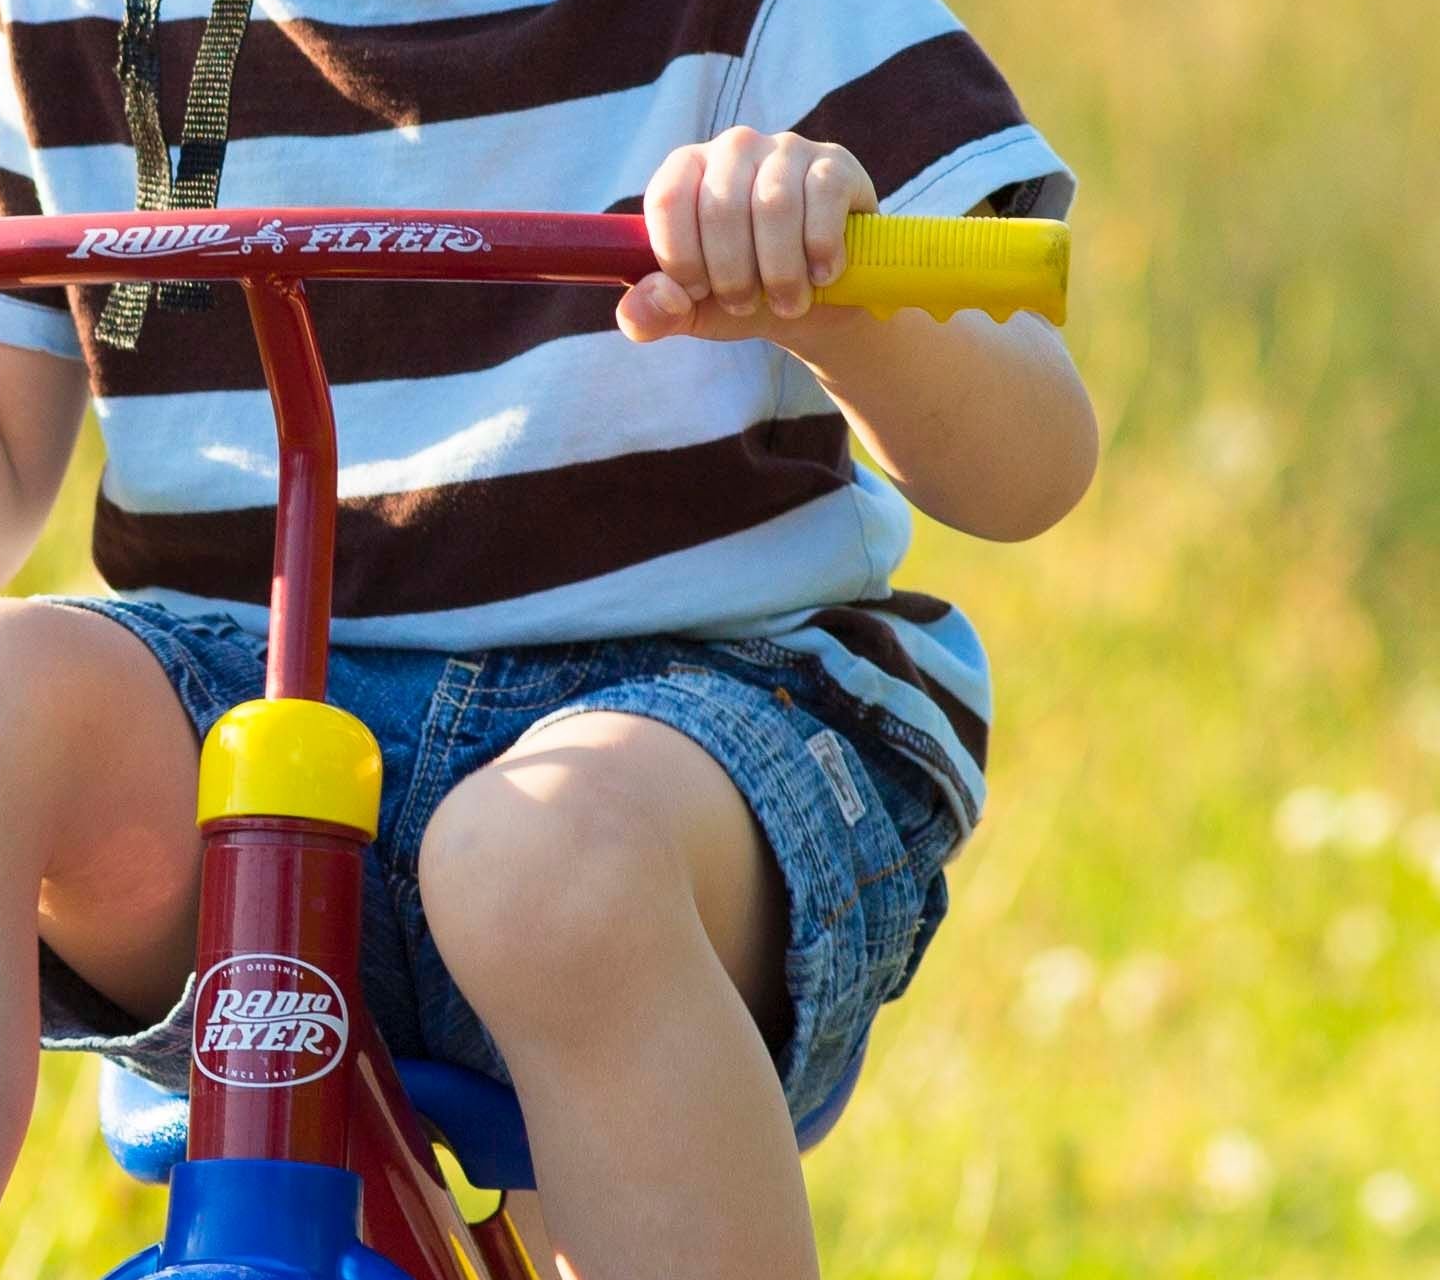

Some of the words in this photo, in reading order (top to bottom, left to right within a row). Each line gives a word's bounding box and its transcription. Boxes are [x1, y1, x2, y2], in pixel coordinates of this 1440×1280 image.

[66, 223, 232, 259] RADIO
[300, 223, 484, 253] FLYER
[222, 965, 241, 978] THE
[246, 963, 304, 980] ORIGINAL
[207, 989, 333, 1024] RADIO
[199, 1019, 325, 1055] FLYER
